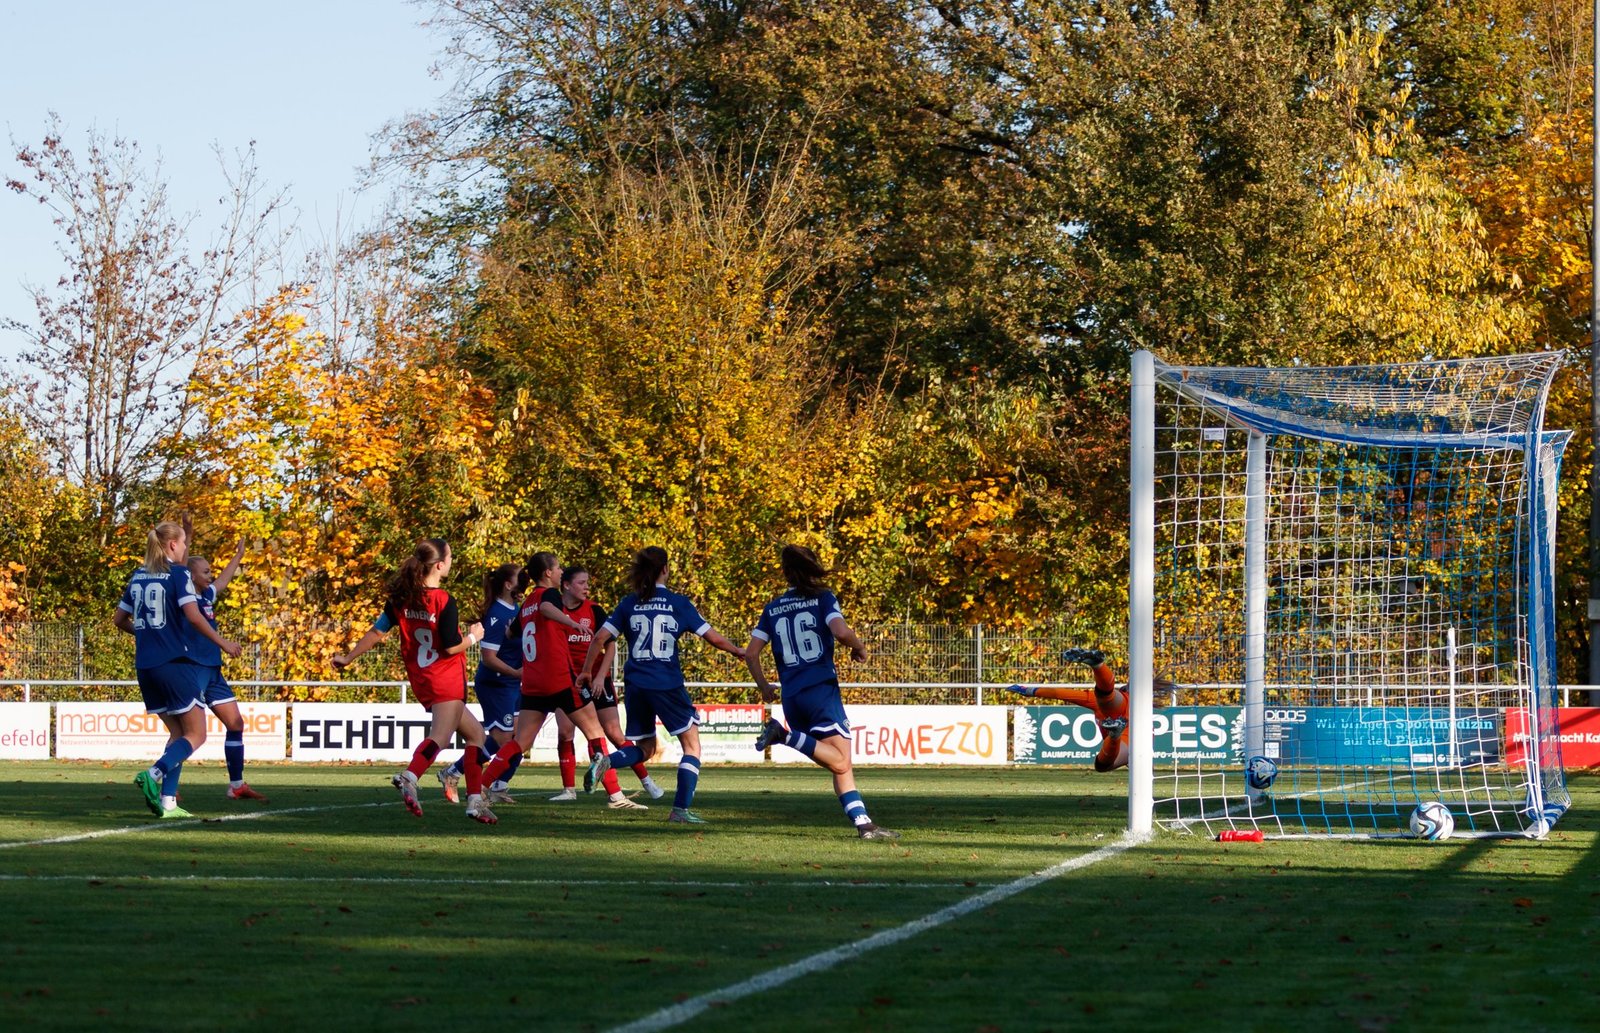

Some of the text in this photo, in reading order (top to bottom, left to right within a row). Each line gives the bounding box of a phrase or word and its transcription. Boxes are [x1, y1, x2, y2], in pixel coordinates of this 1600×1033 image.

[130, 582, 166, 630] 29
[768, 598, 819, 616] LEUCHTMANN
[414, 627, 439, 668] 8
[522, 621, 537, 662] 6
[629, 614, 679, 662] 26
[775, 611, 824, 667] 16
[709, 709, 762, 724] glücklich!
[1041, 713, 1227, 748] COPES
[1316, 718, 1494, 731] Wir bringen Sportmdizin
[851, 721, 993, 760] TERMEZZO
[1344, 735, 1364, 746] auf
[1367, 735, 1391, 746] den
